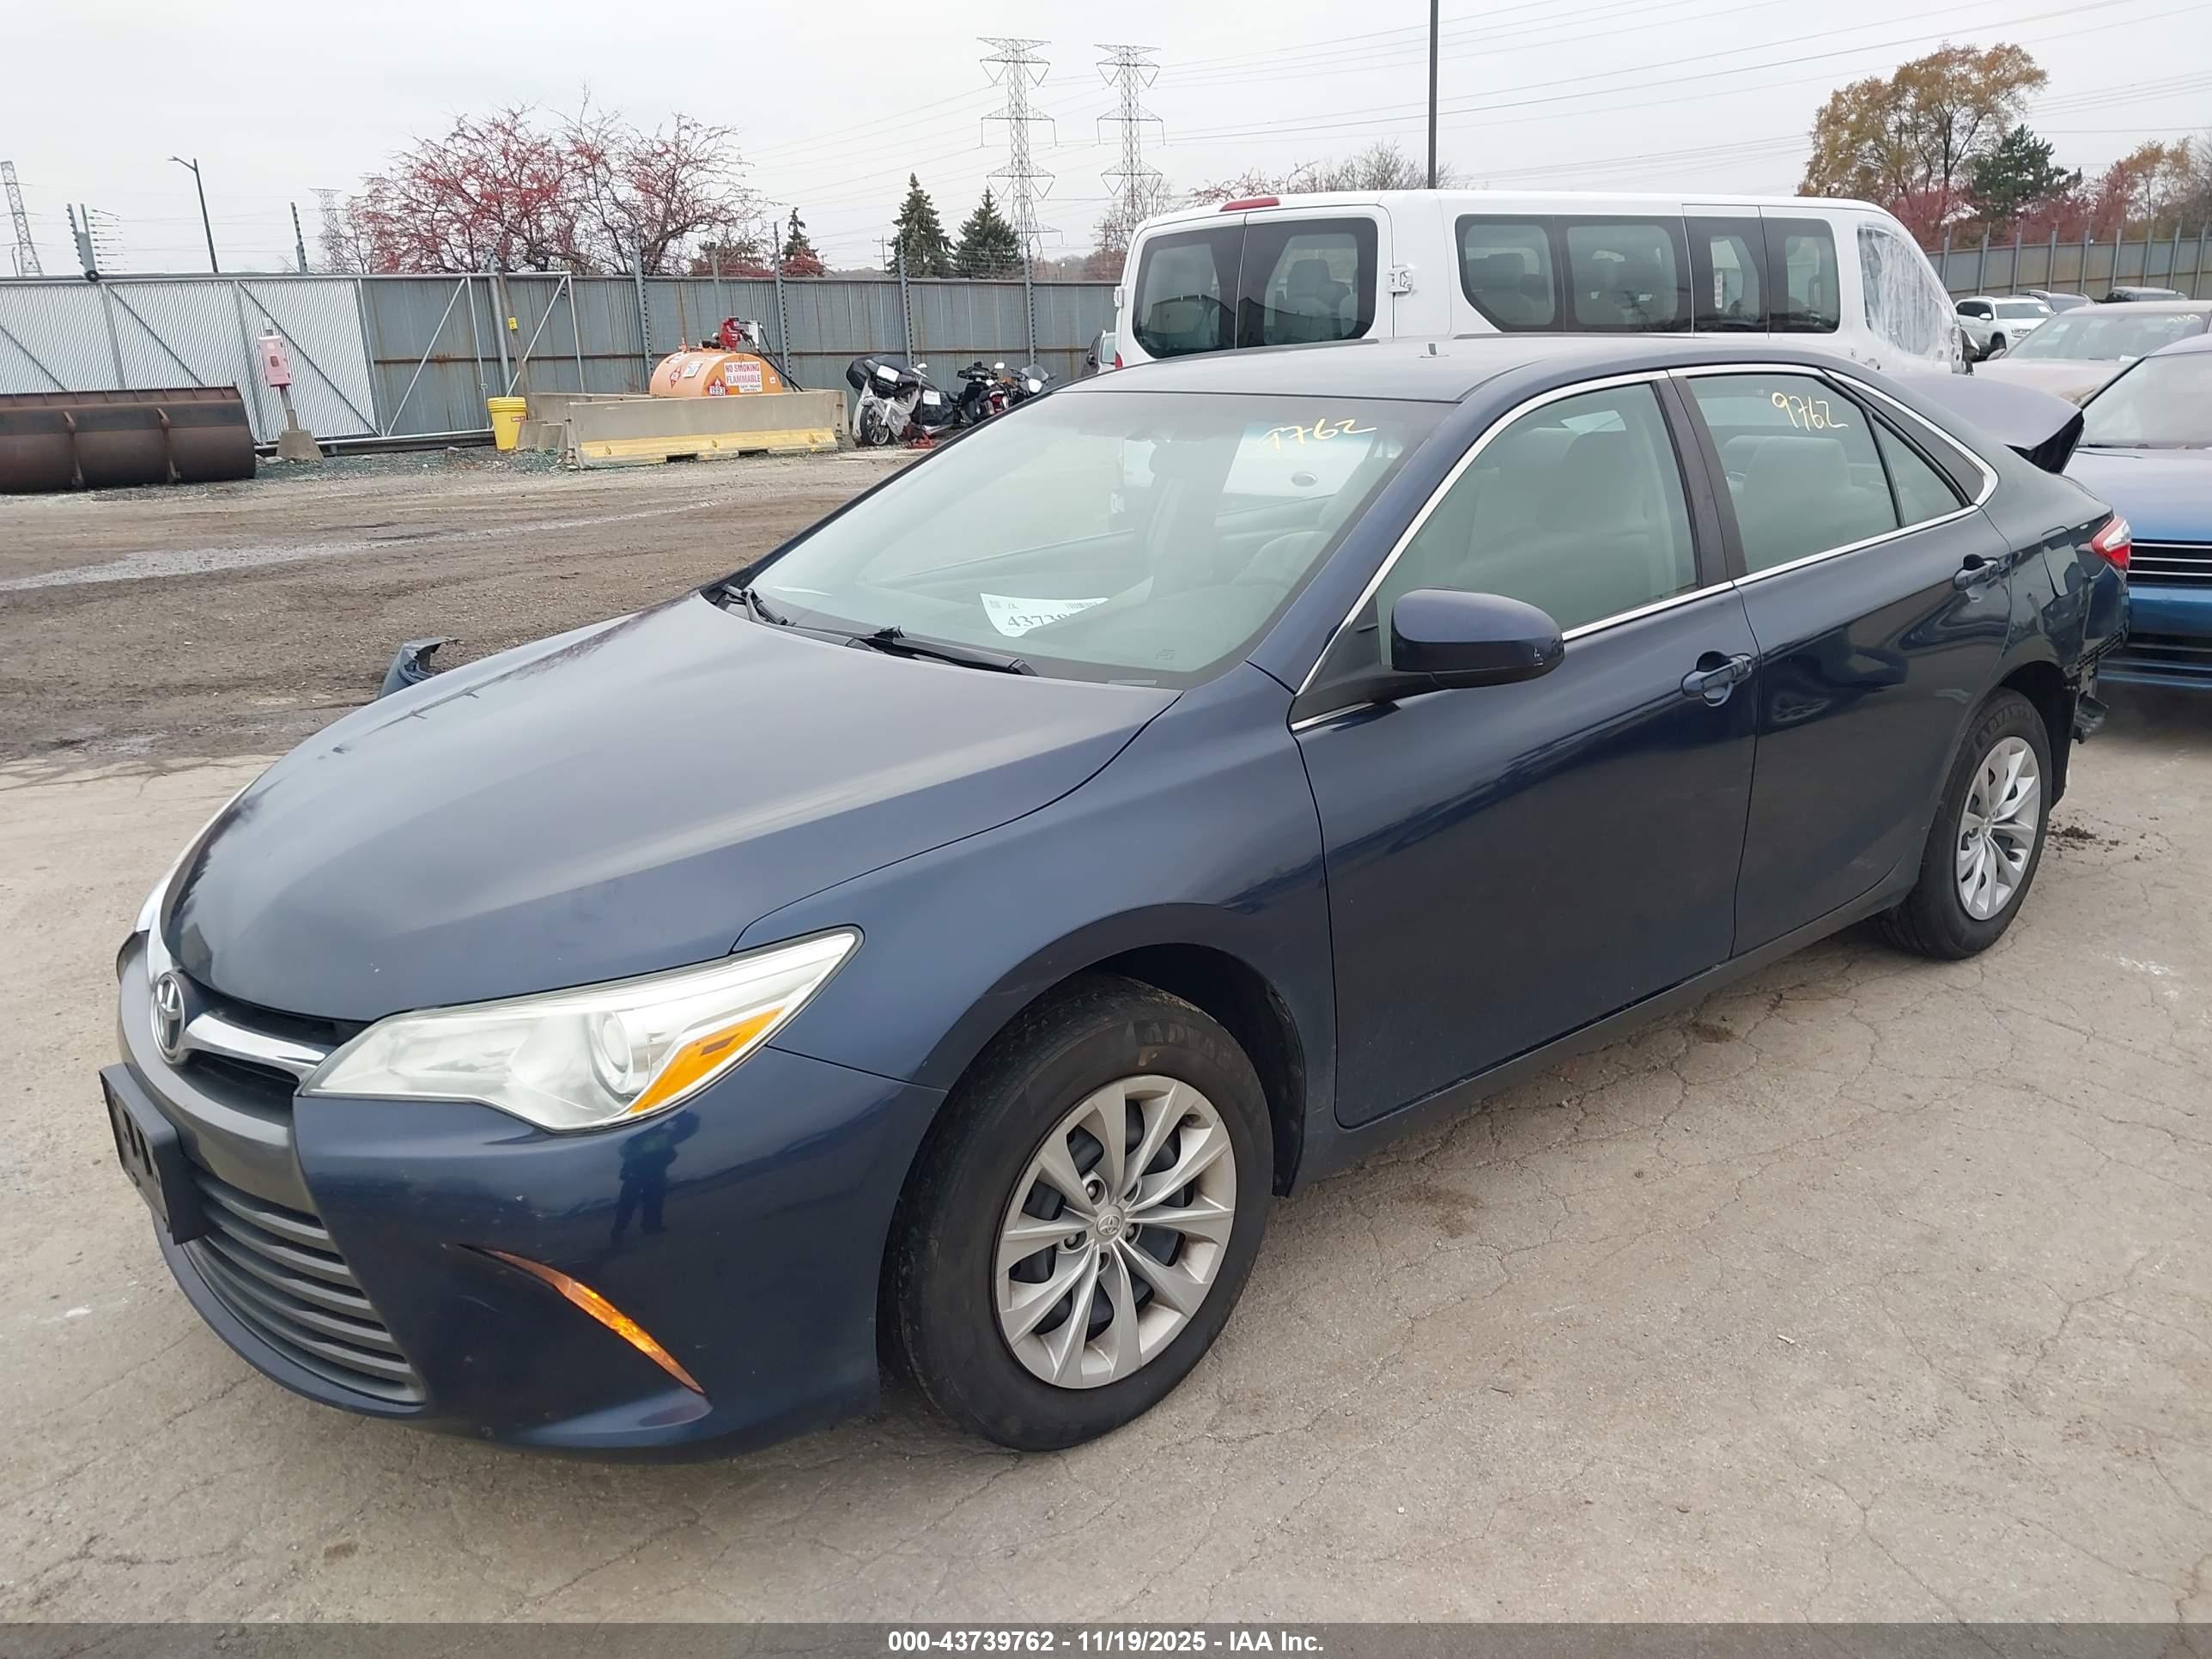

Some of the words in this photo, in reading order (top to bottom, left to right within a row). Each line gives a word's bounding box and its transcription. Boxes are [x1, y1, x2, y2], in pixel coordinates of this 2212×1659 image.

[726, 363, 732, 373] NO
[734, 362, 760, 372] SMOKING
[726, 374, 761, 384] FLAMMABLE
[711, 386, 725, 395] 1993
[1771, 392, 1848, 431] 9762
